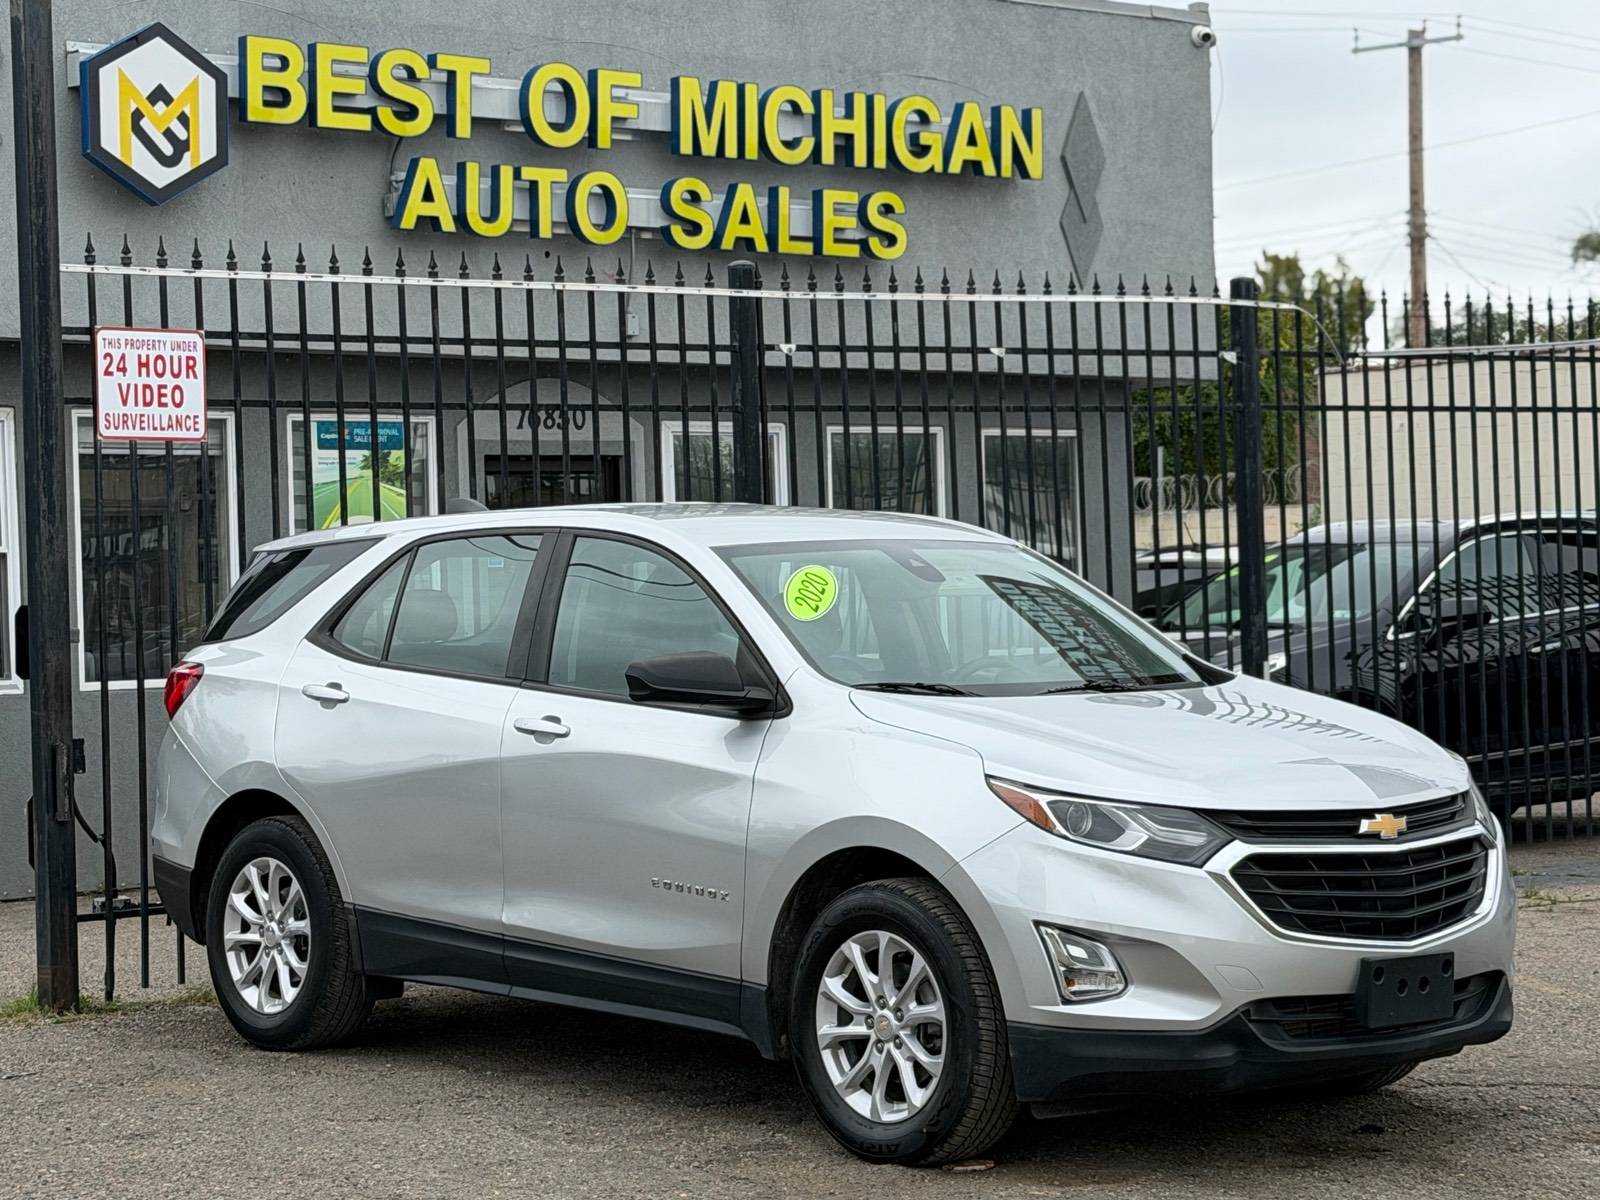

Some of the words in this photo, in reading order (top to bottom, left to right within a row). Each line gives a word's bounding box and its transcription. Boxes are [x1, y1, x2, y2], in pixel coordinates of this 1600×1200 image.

[239, 34, 492, 139] BEST
[519, 62, 643, 149] OF
[670, 75, 1044, 180] MICHIGAN
[391, 156, 630, 245] AUTO
[660, 177, 909, 260] SALES
[102, 338, 122, 350] THIS
[125, 339, 168, 352] PROPERTY
[171, 341, 199, 353] UNDER
[103, 352, 128, 378] 24
[137, 354, 199, 380] HOUR
[117, 383, 185, 409] VIDEO
[104, 413, 200, 433] SURVEILLANCE
[794, 572, 829, 613] 2020
[650, 877, 729, 903] EQUINOX
